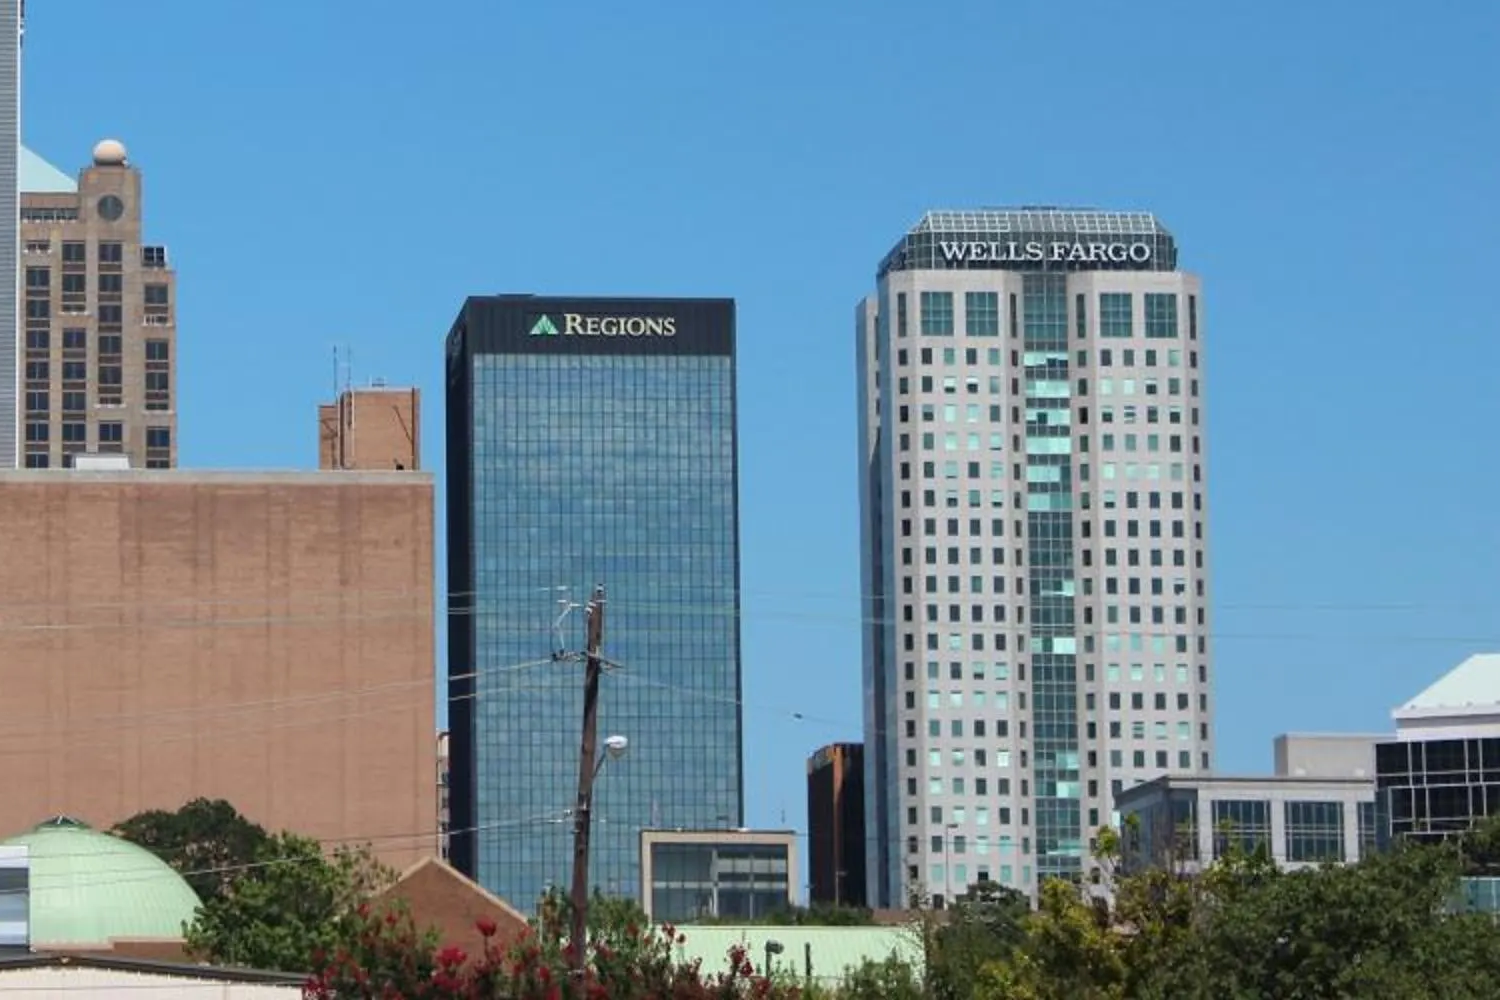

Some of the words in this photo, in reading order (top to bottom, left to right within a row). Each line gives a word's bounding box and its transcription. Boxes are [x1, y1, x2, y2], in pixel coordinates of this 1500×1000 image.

[940, 241, 1043, 262] WELLS
[1050, 241, 1151, 262] FARGO
[564, 313, 676, 336] REGIONS
